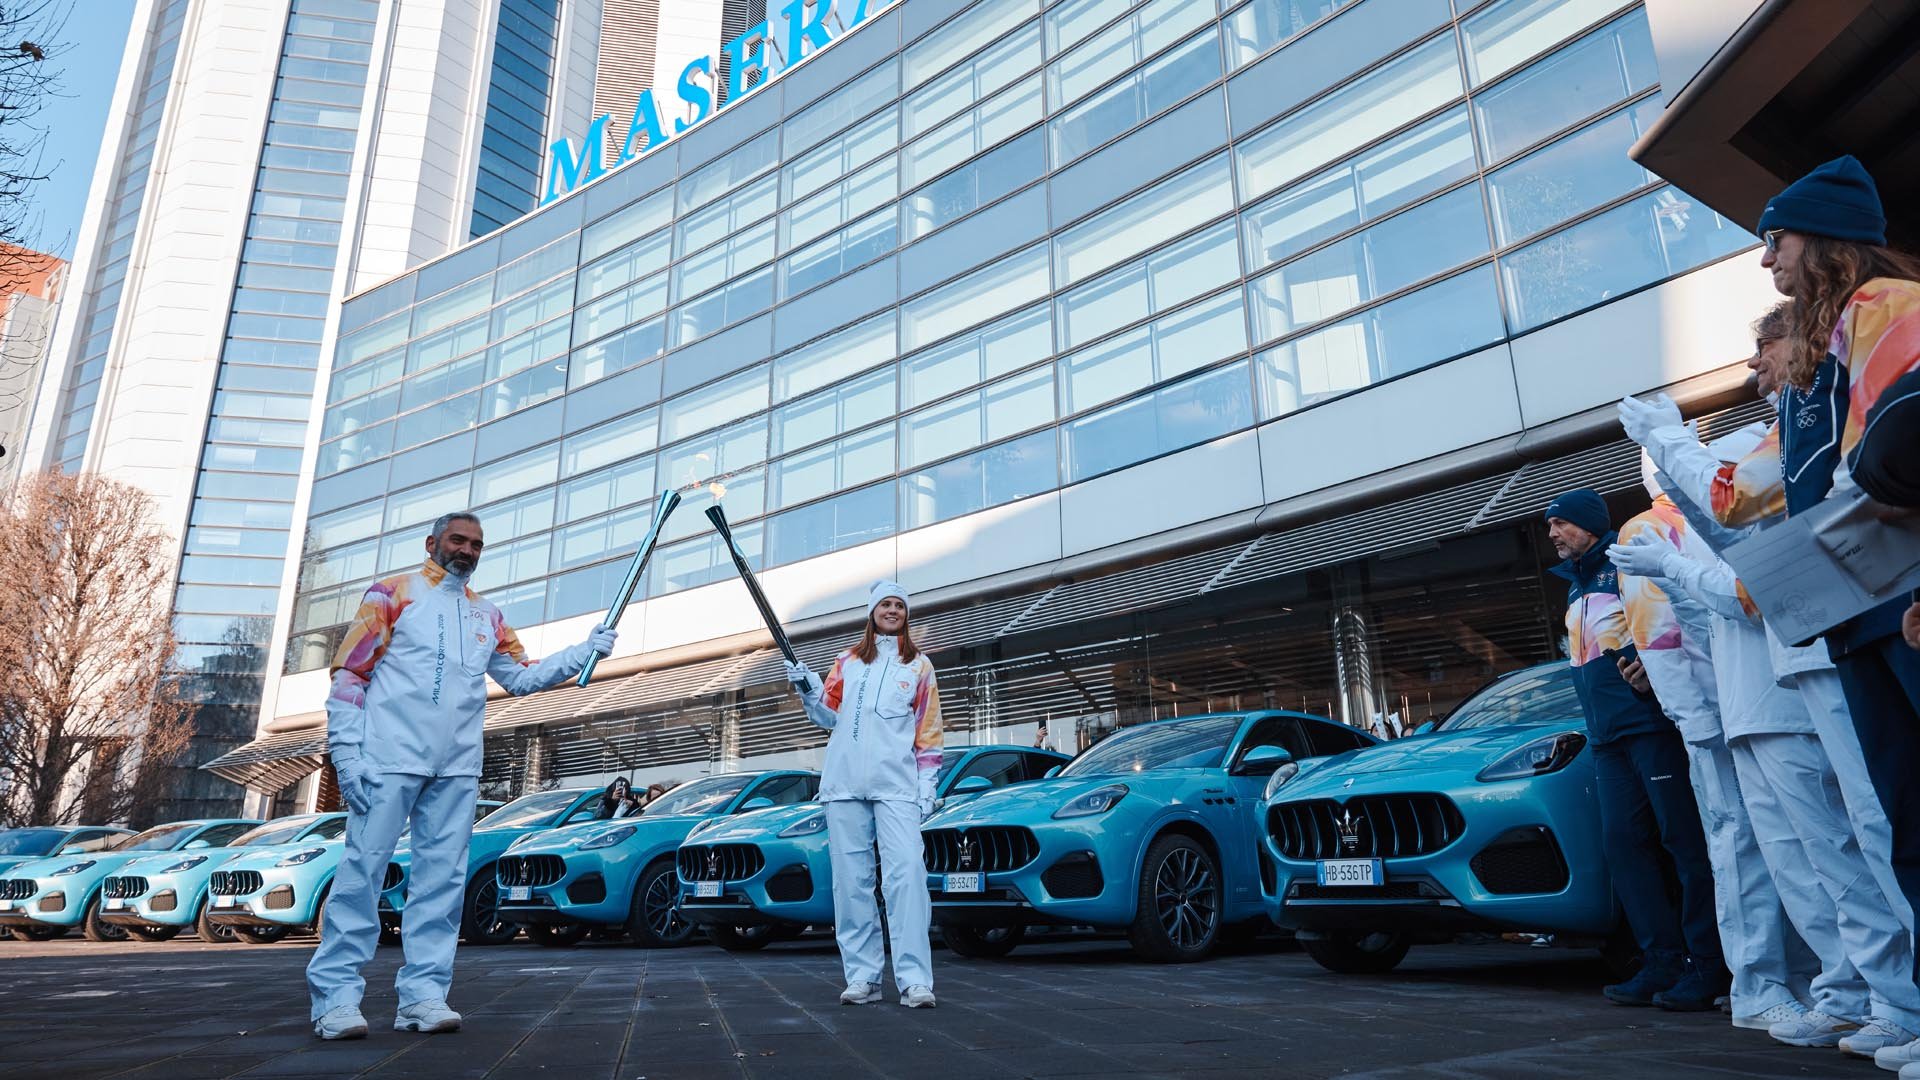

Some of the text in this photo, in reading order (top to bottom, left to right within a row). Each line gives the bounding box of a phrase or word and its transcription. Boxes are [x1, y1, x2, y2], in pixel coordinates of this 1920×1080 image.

[431, 666, 443, 705] MILANO
[437, 631, 446, 667] CORTINA
[856, 680, 867, 710] CORTINA
[852, 711, 861, 742] MILANO
